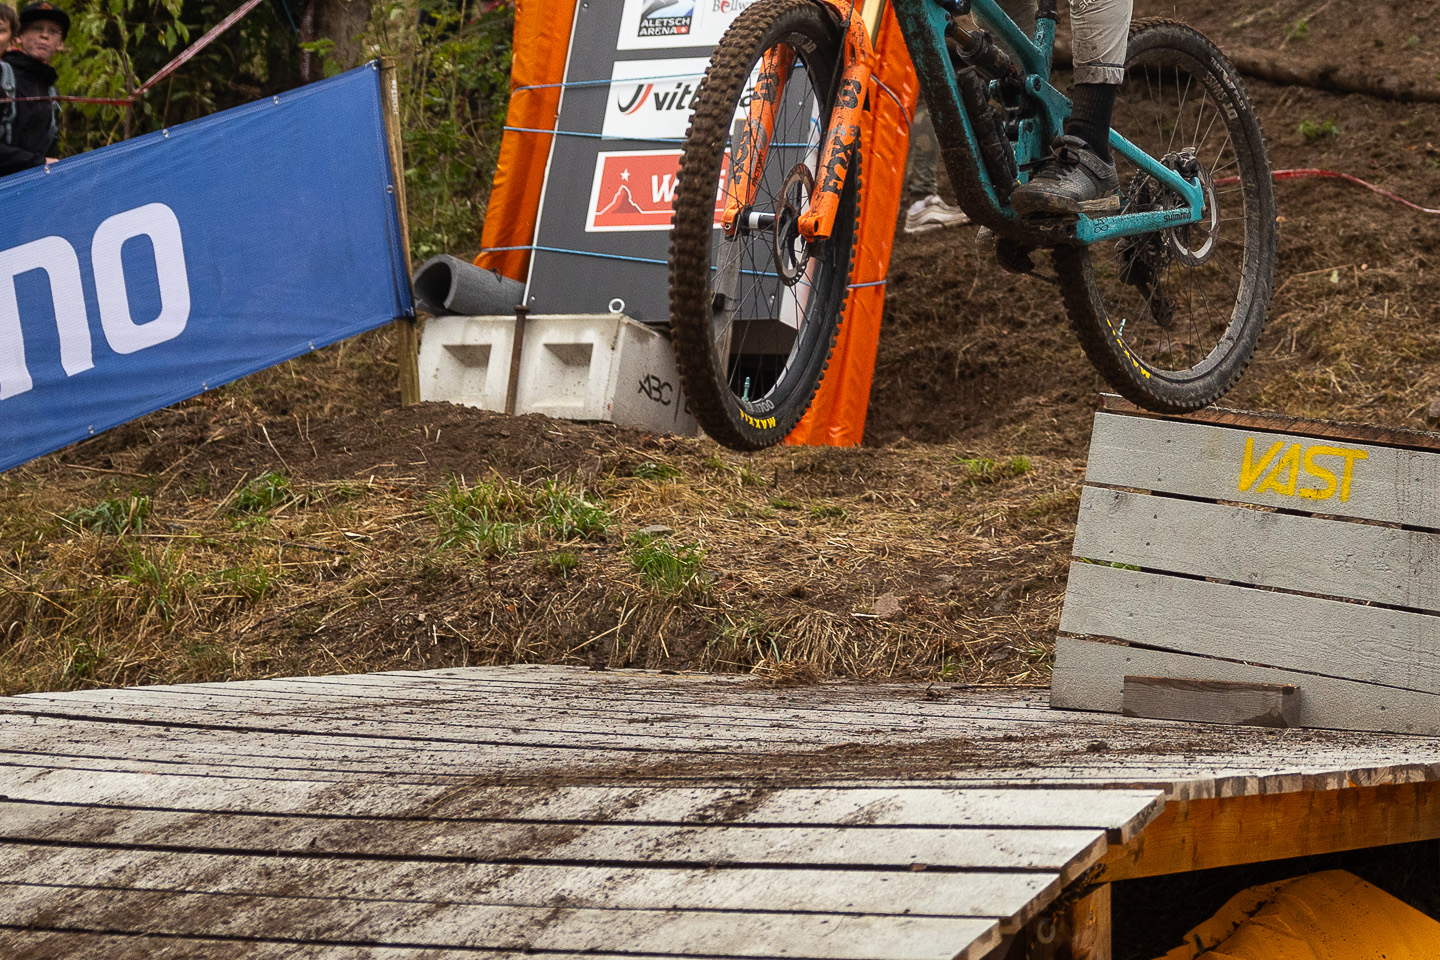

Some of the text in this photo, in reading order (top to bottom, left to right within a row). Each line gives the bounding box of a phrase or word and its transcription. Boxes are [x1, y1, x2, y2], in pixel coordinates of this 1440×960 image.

[640, 17, 691, 28] ALETSCH
[638, 25, 678, 36] ARENA
[1238, 437, 1368, 503] VAST
